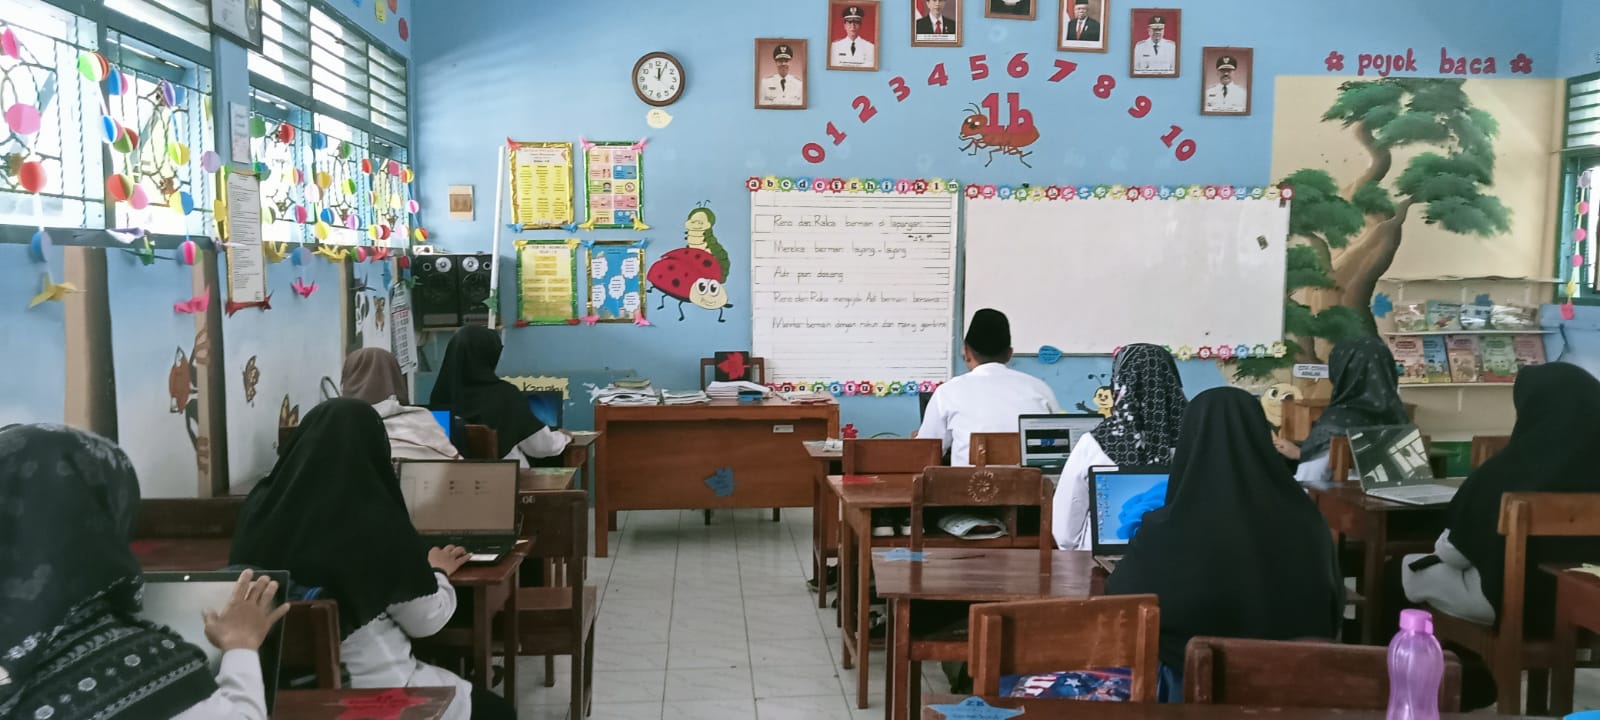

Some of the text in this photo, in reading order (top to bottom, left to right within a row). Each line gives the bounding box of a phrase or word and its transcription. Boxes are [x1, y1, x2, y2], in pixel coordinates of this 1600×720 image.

[1357, 47, 1496, 77] pojok baca
[802, 52, 1197, 164] 0 1 2 3 4 5 6 7 8 9 10
[981, 92, 1034, 134] 1b
